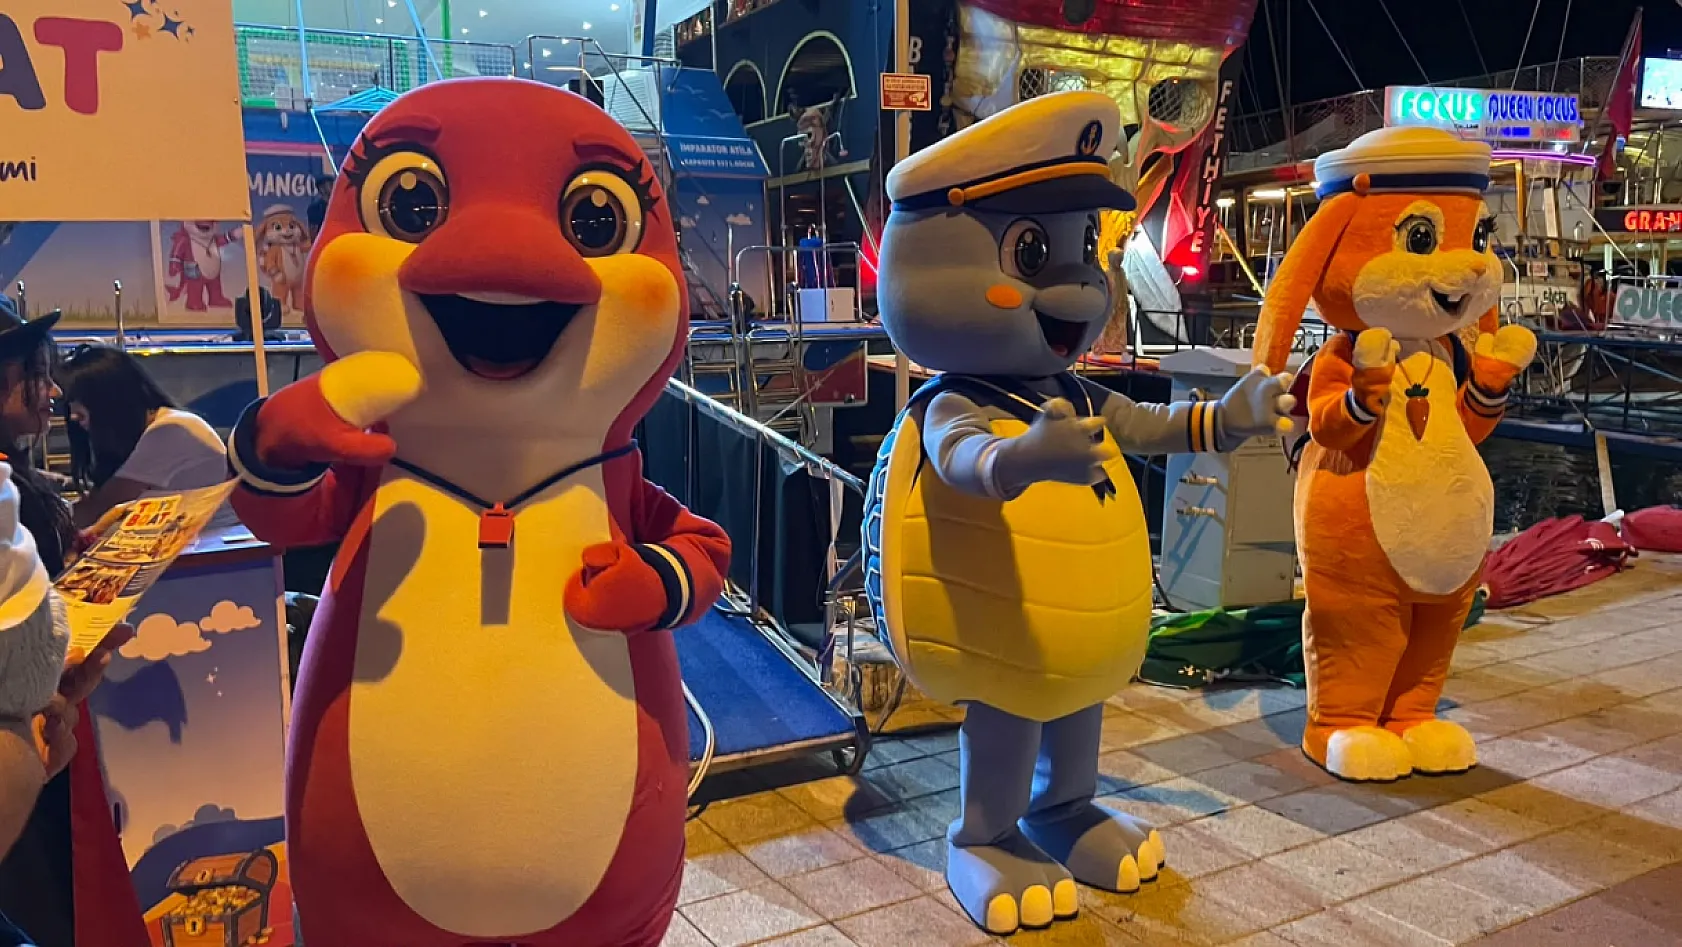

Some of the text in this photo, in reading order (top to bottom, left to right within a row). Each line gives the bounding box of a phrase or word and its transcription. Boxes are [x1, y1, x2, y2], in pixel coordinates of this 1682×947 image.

[1400, 90, 1578, 123] FOCUS QUEEN FOCUS
